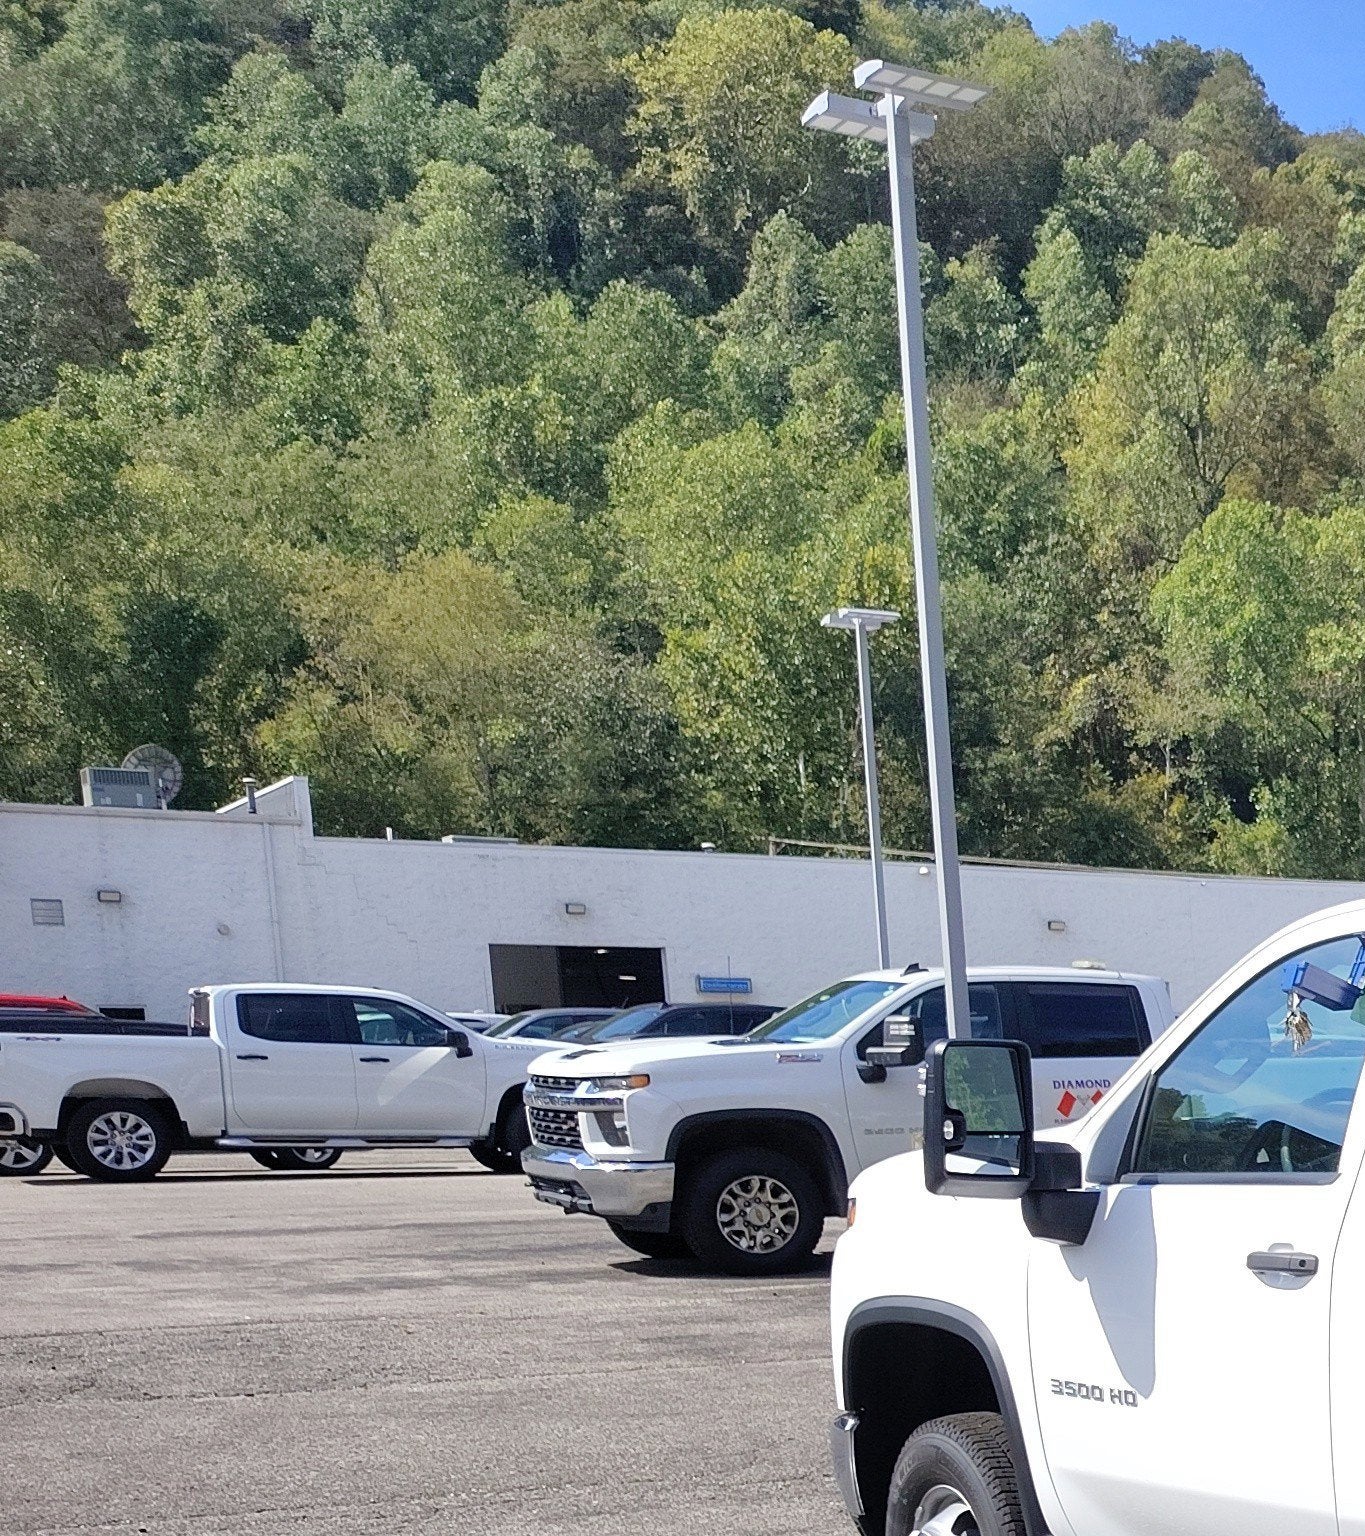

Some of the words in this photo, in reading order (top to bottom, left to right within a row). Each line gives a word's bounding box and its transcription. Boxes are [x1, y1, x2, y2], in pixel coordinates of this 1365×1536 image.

[1052, 1079, 1112, 1090] DIAMOND
[1050, 1378, 1104, 1402] 3500
[1109, 1388, 1138, 1408] HD
